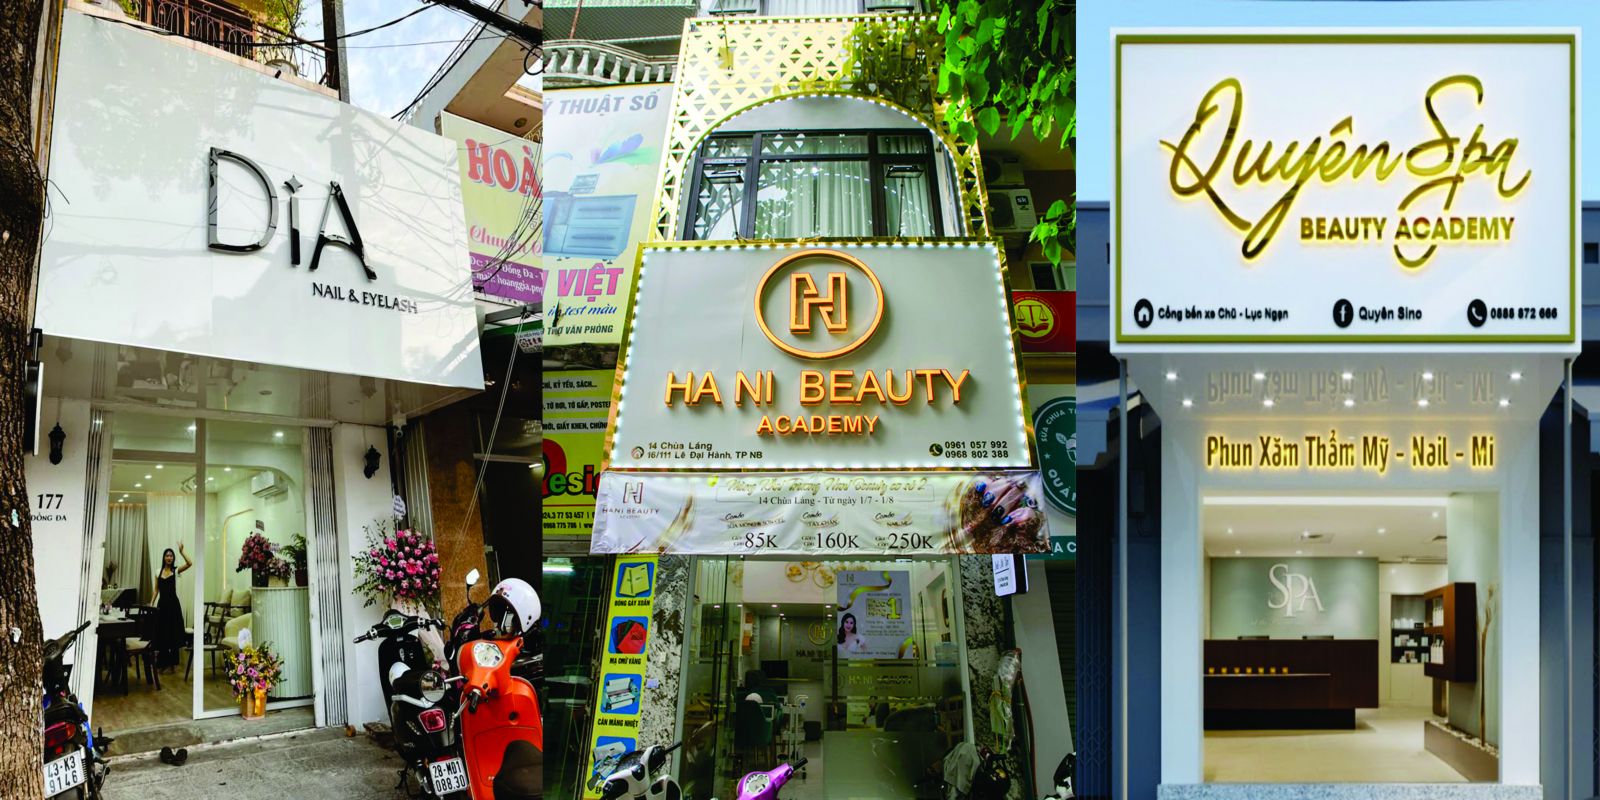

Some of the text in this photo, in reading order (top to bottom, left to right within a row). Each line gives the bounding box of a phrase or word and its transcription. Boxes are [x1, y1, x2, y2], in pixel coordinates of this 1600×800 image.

[559, 93, 625, 117] THUẬT
[629, 88, 661, 112] SỐ
[1159, 74, 1533, 269] Quyên Spa
[1300, 216, 1515, 241] BEAUTY ACADEMY
[557, 262, 624, 303] VIỆT
[312, 282, 418, 315] NAIL & EYELASH
[799, 369, 971, 406] BEAUTY
[756, 414, 880, 436] ACADEMY
[648, 441, 713, 451] 14 Chùa Láng
[944, 441, 1008, 449] 0961 057 992
[945, 450, 1009, 459] 0968 802 388
[1207, 436, 1252, 467] Phun
[1259, 436, 1299, 467] Xăm
[1304, 429, 1355, 467] Thẩm
[1362, 436, 1390, 473] Mỹ
[1412, 436, 1449, 467] Nail
[1471, 436, 1494, 467] Mi
[647, 451, 671, 459] 16/111
[690, 451, 704, 460] Đại
[736, 451, 747, 459] TP
[749, 451, 763, 459] NB
[37, 494, 64, 509] 177
[759, 496, 768, 505] 14
[745, 532, 778, 549] 85K
[816, 533, 860, 549] 160K
[888, 533, 934, 549] 250K
[1268, 563, 1325, 618] SPA
[49, 770, 78, 793] 9146
[435, 774, 466, 793] 088.30
